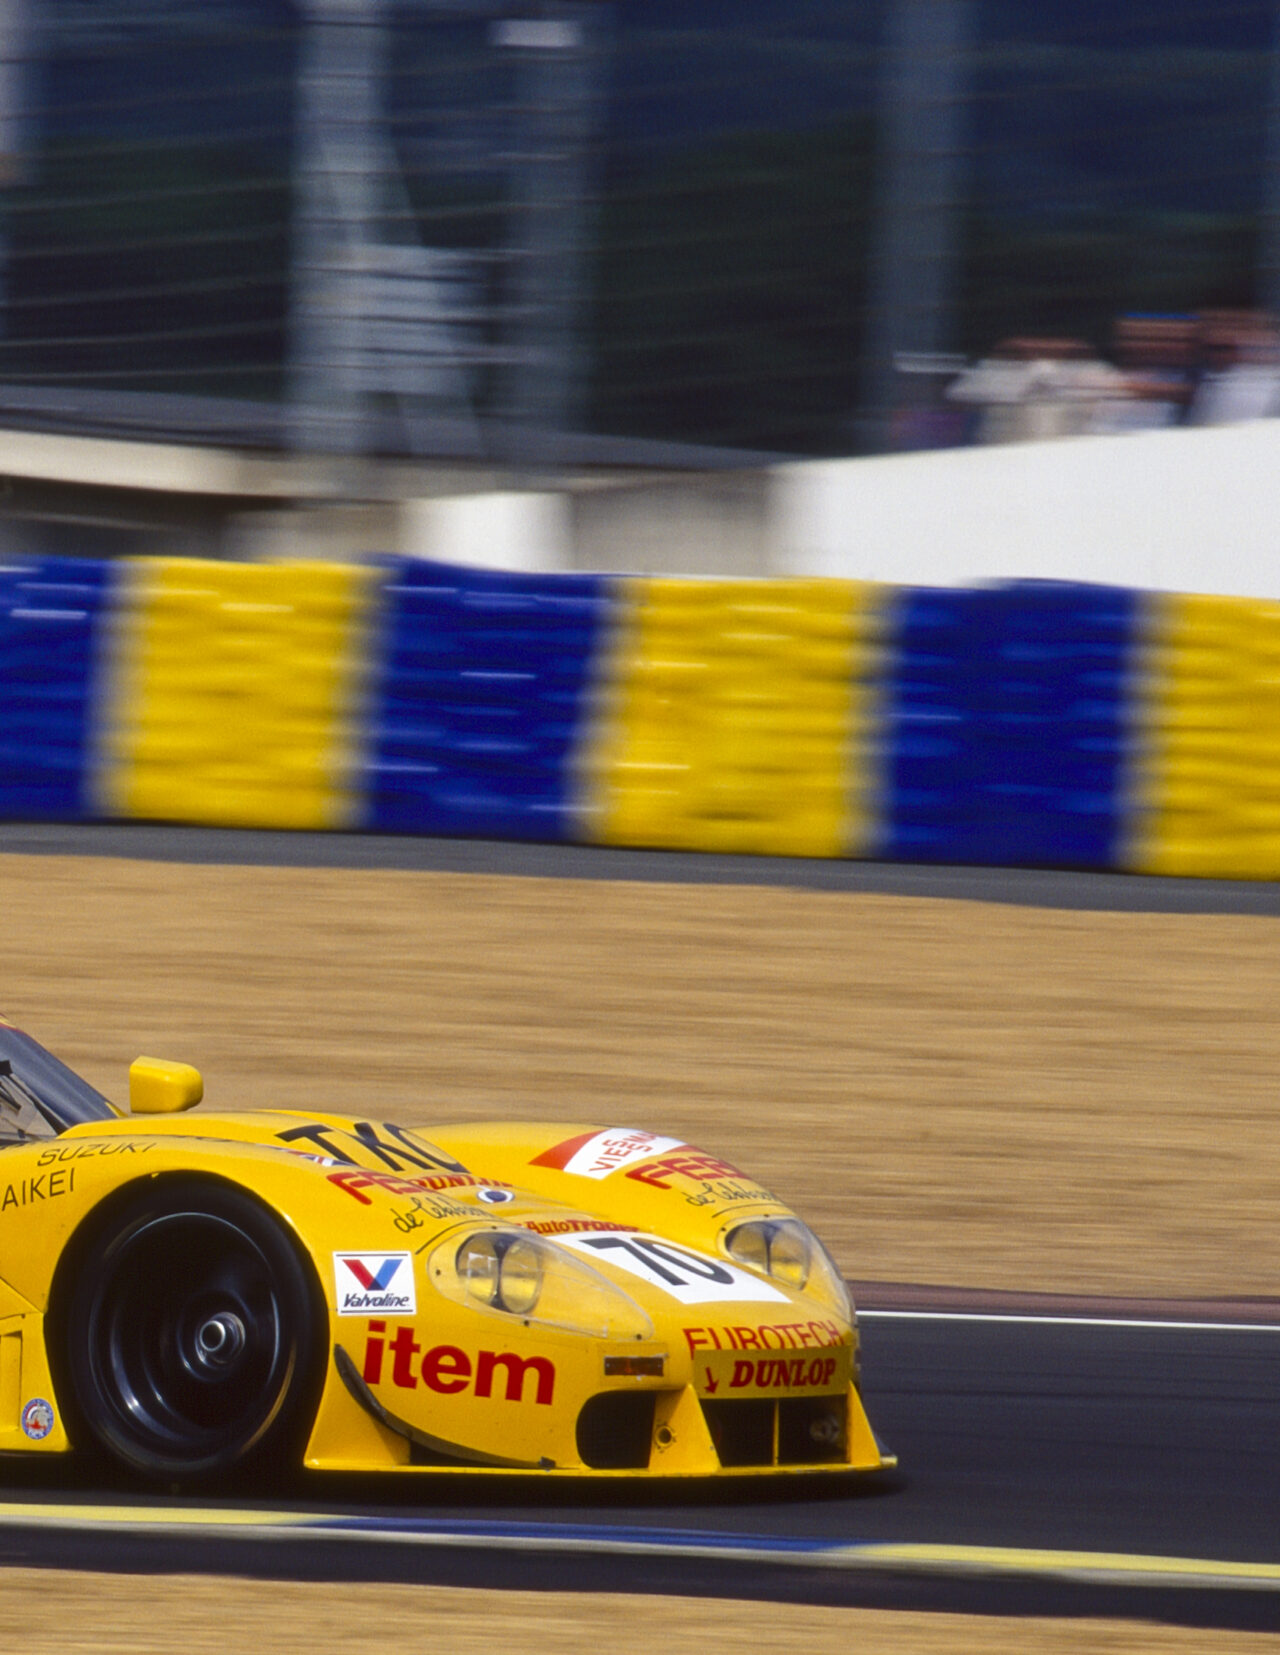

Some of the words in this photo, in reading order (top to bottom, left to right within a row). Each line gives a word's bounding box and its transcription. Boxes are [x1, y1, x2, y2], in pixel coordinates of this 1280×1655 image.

[37, 1142, 158, 1168] SUZUKI
[578, 1237, 735, 1287] 70
[343, 1293, 410, 1307] Valvoline
[363, 1319, 556, 1405] item
[729, 1357, 837, 1388] DUNLOP
